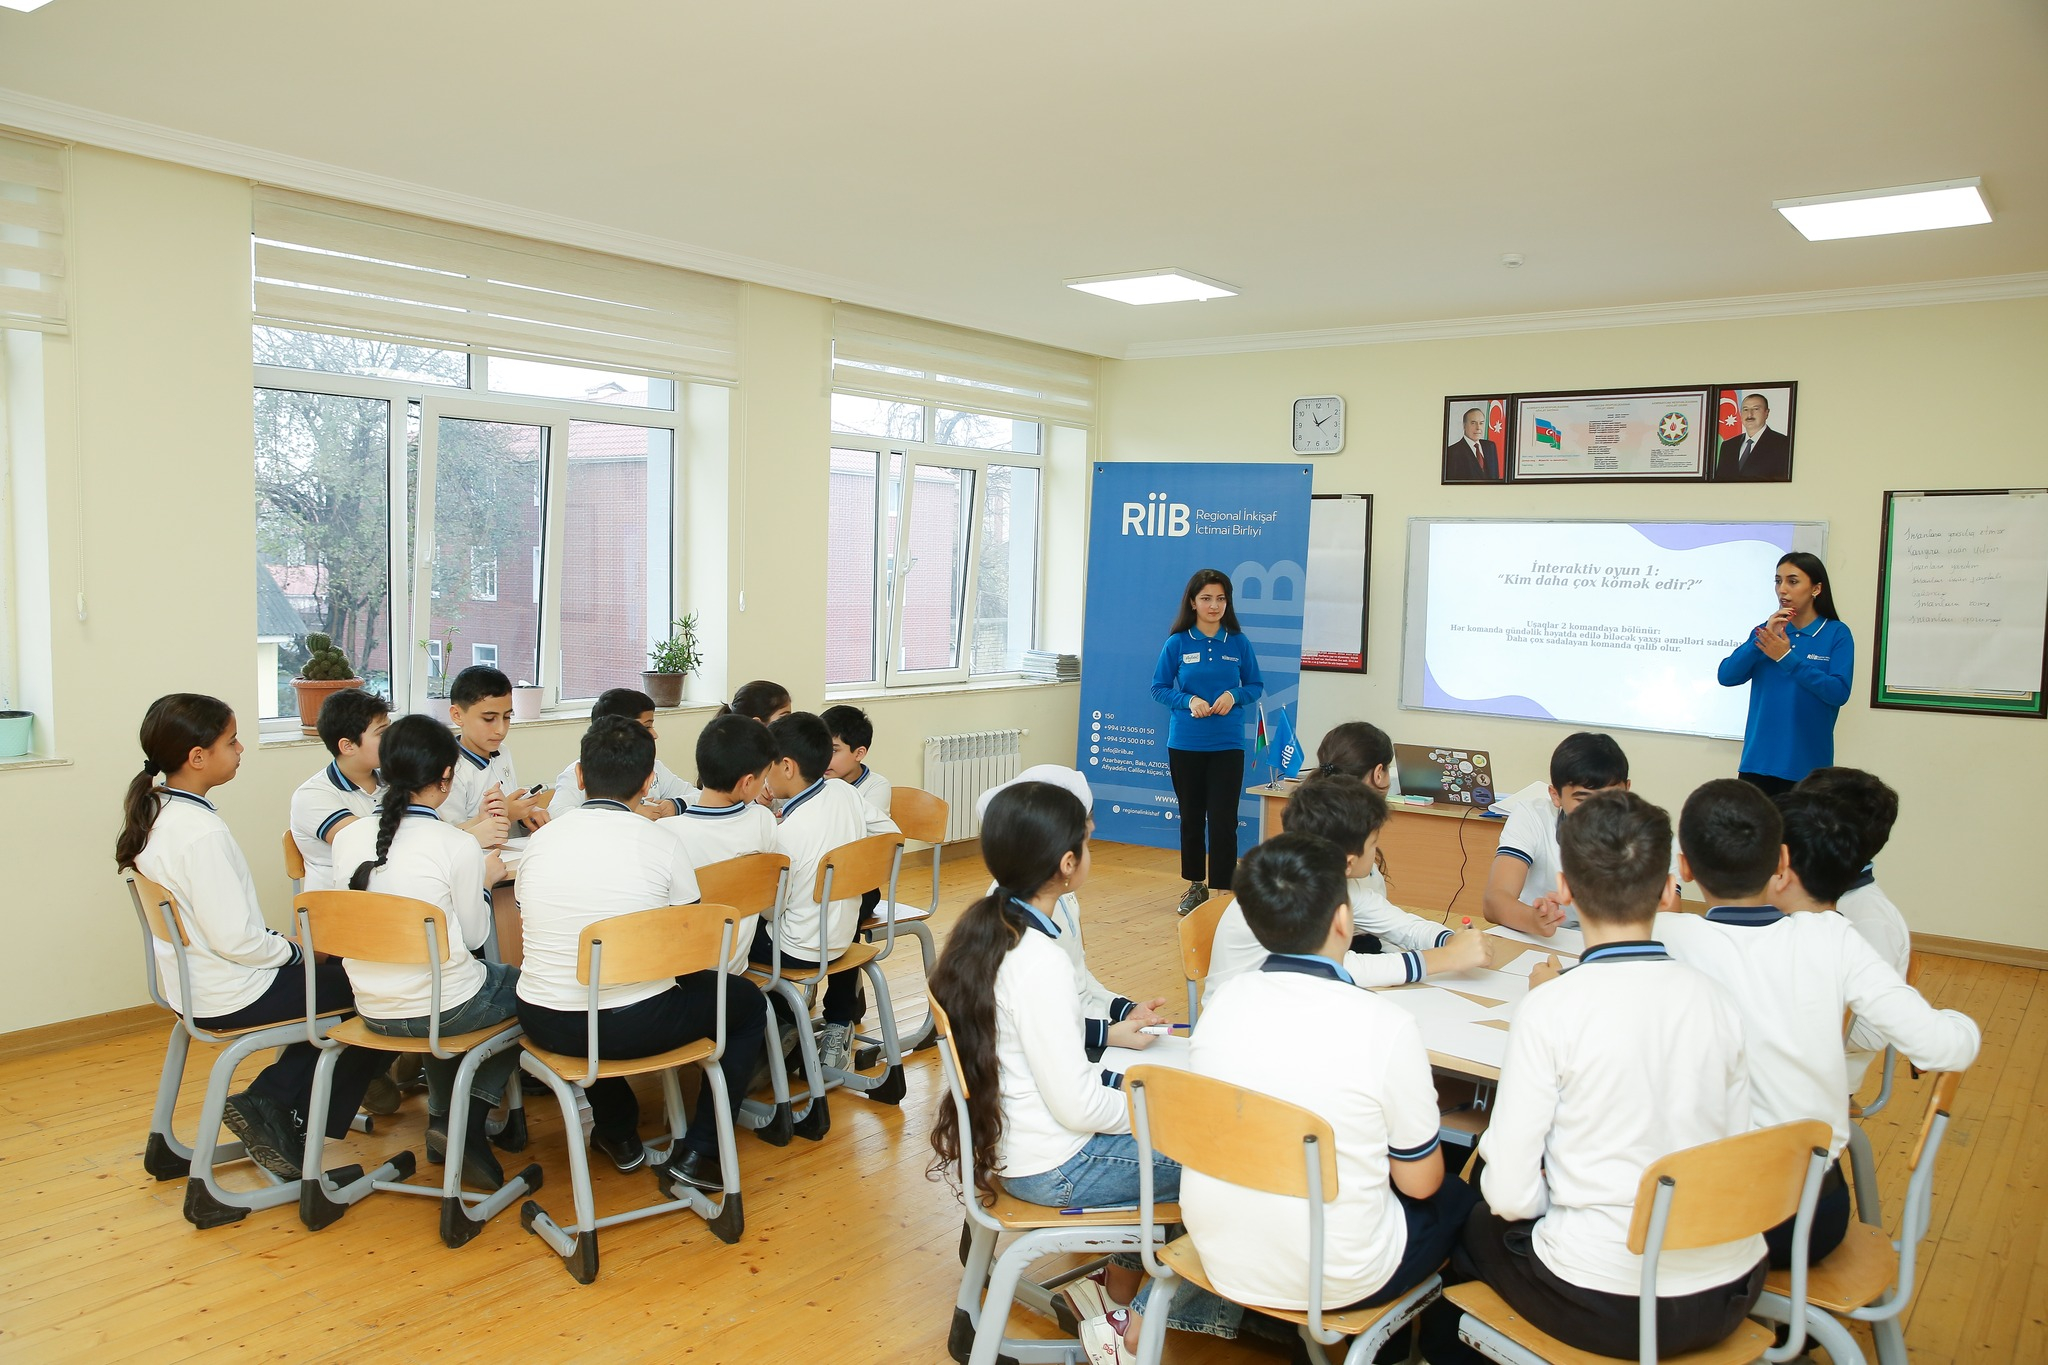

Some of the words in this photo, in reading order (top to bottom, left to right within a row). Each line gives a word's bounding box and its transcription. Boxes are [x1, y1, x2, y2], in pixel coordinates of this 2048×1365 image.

[1196, 509, 1241, 522] Regional
[1243, 508, 1278, 524] İnkişaf
[1195, 524, 1230, 535] İctimai
[1232, 525, 1262, 537] Birliyi
[1531, 560, 1600, 574] İnteraktiv
[1604, 566, 1640, 578] oyun
[1646, 565, 1660, 576] 1:
[1536, 575, 1568, 587] daha
[1573, 577, 1596, 589] çox
[1601, 576, 1650, 590] kömək
[1467, 625, 1503, 634] komanda
[1506, 628, 1541, 636] gündəlik
[1580, 631, 1600, 640] edilə
[1604, 632, 1639, 642] biləcək
[1527, 620, 1559, 630] Uşaqlar
[1569, 623, 1618, 633] komandaya
[1622, 625, 1660, 634] bölünür:
[1506, 634, 1528, 642] Daha
[1546, 637, 1588, 647] sadalayan
[1590, 640, 1631, 649] komanda
[1634, 642, 1657, 652] qalib
